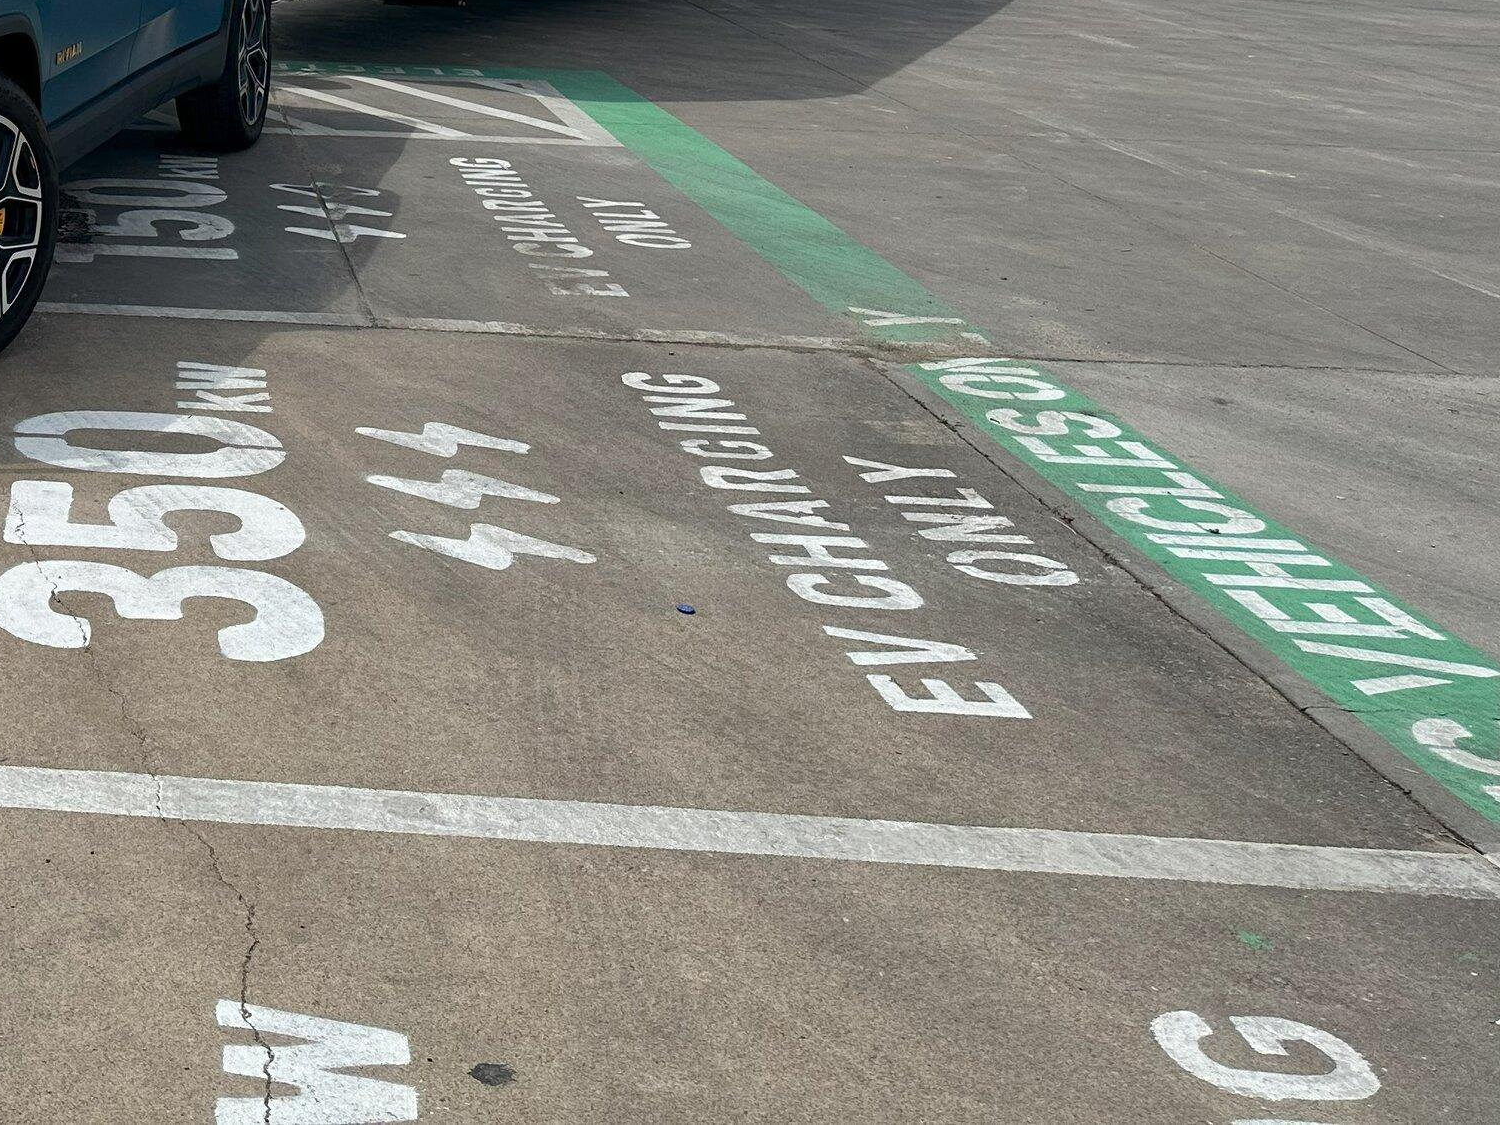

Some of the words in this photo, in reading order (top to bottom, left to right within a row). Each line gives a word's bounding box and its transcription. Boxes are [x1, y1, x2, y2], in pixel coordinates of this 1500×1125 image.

[449, 157, 593, 258] CHARGING
[576, 196, 692, 249] ONLY
[621, 372, 924, 610] CHARGING
[842, 455, 1081, 586] ONLY
[985, 407, 1500, 696] VEHICLES
[823, 625, 1033, 719] EV
